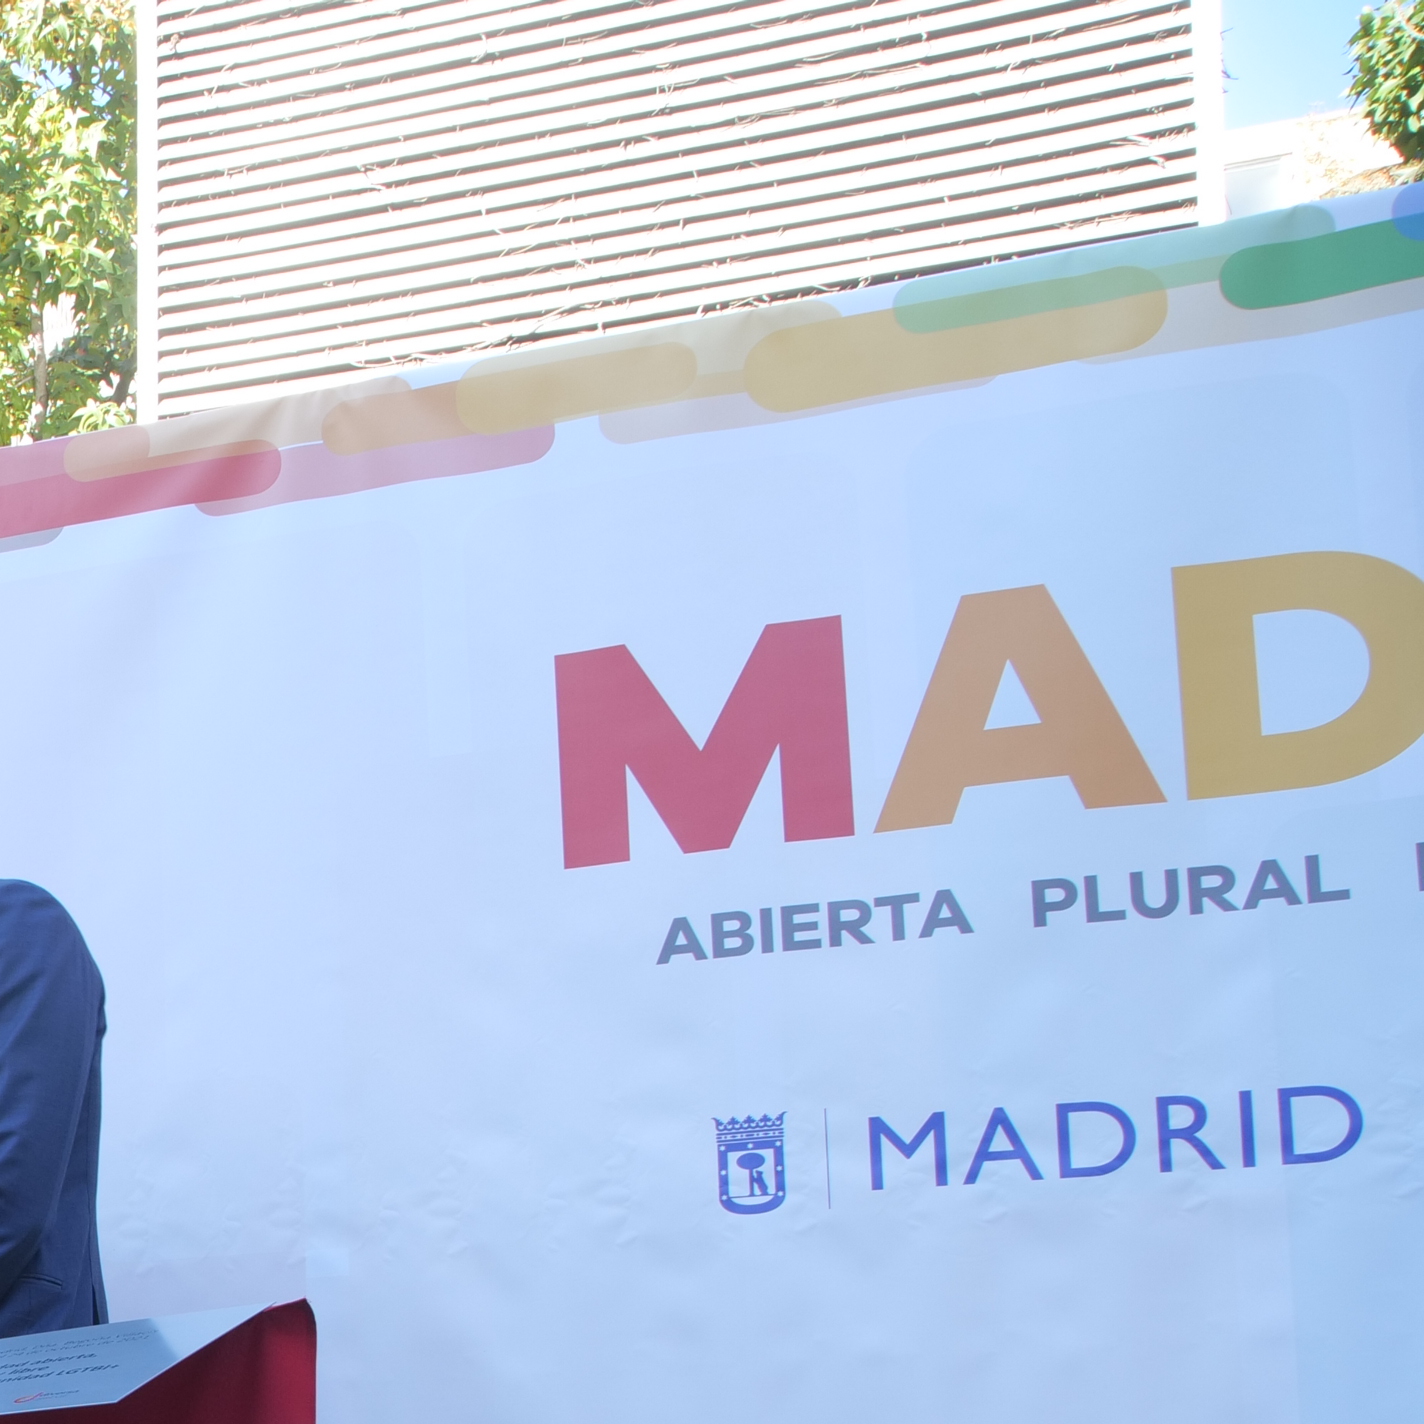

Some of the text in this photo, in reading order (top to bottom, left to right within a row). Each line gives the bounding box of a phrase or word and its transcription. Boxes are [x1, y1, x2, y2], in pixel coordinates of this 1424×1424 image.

[553, 549, 1424, 869] MAD
[655, 889, 974, 965] ABIERTA
[1030, 854, 1351, 928] PLURAL
[867, 1085, 1364, 1191] MADRID
[8, 1365, 50, 1376] libre
[29, 1353, 98, 1367] abierta,
